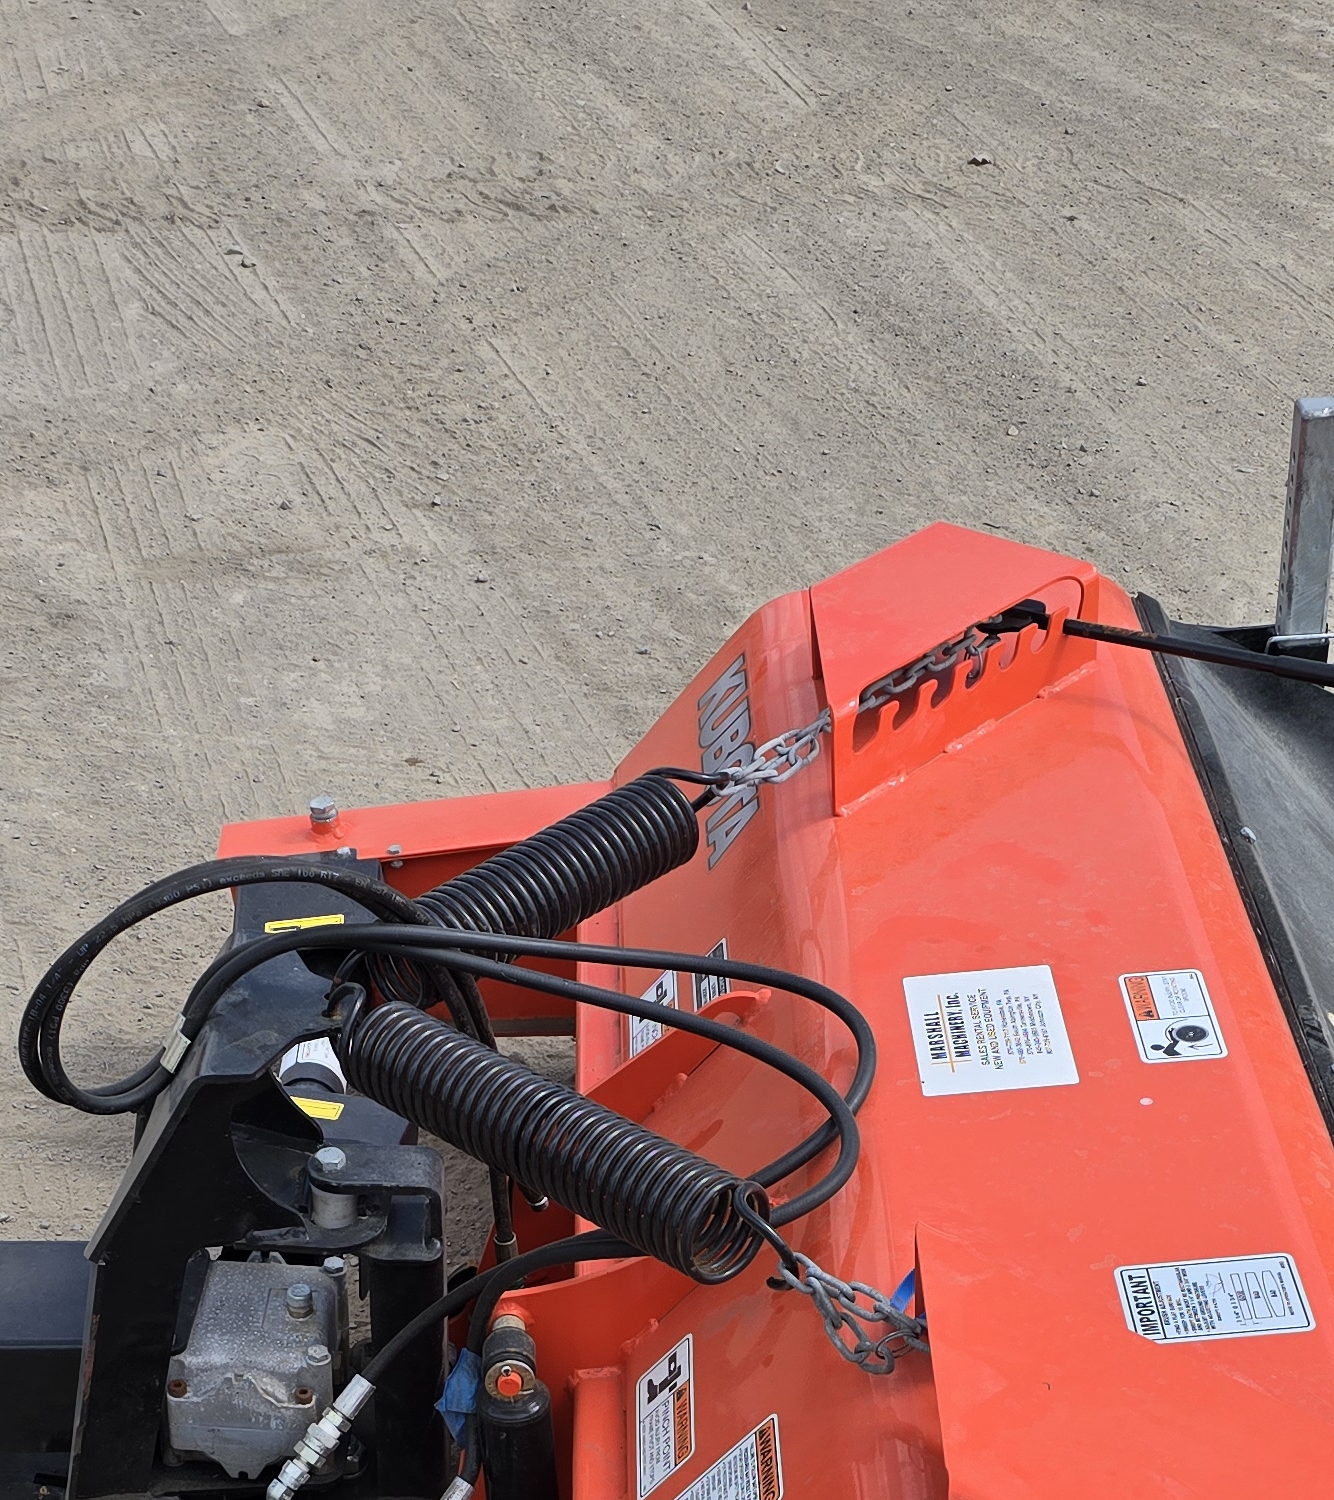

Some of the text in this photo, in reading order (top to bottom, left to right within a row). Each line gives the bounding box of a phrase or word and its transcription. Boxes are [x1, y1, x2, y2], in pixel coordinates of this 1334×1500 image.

[942, 992, 960, 1008] Inc.
[1127, 977, 1152, 1010] WARNING
[923, 1011, 947, 1059] MARSHALL
[966, 994, 990, 1065] SALES RENTAL SERVICE
[977, 988, 1003, 1069] NEW AND USED EQUIPMENT
[1126, 1273, 1161, 1335] IMPORTANT
[661, 1399, 670, 1474] PINCH POINT
[676, 1397, 688, 1460] WARNING
